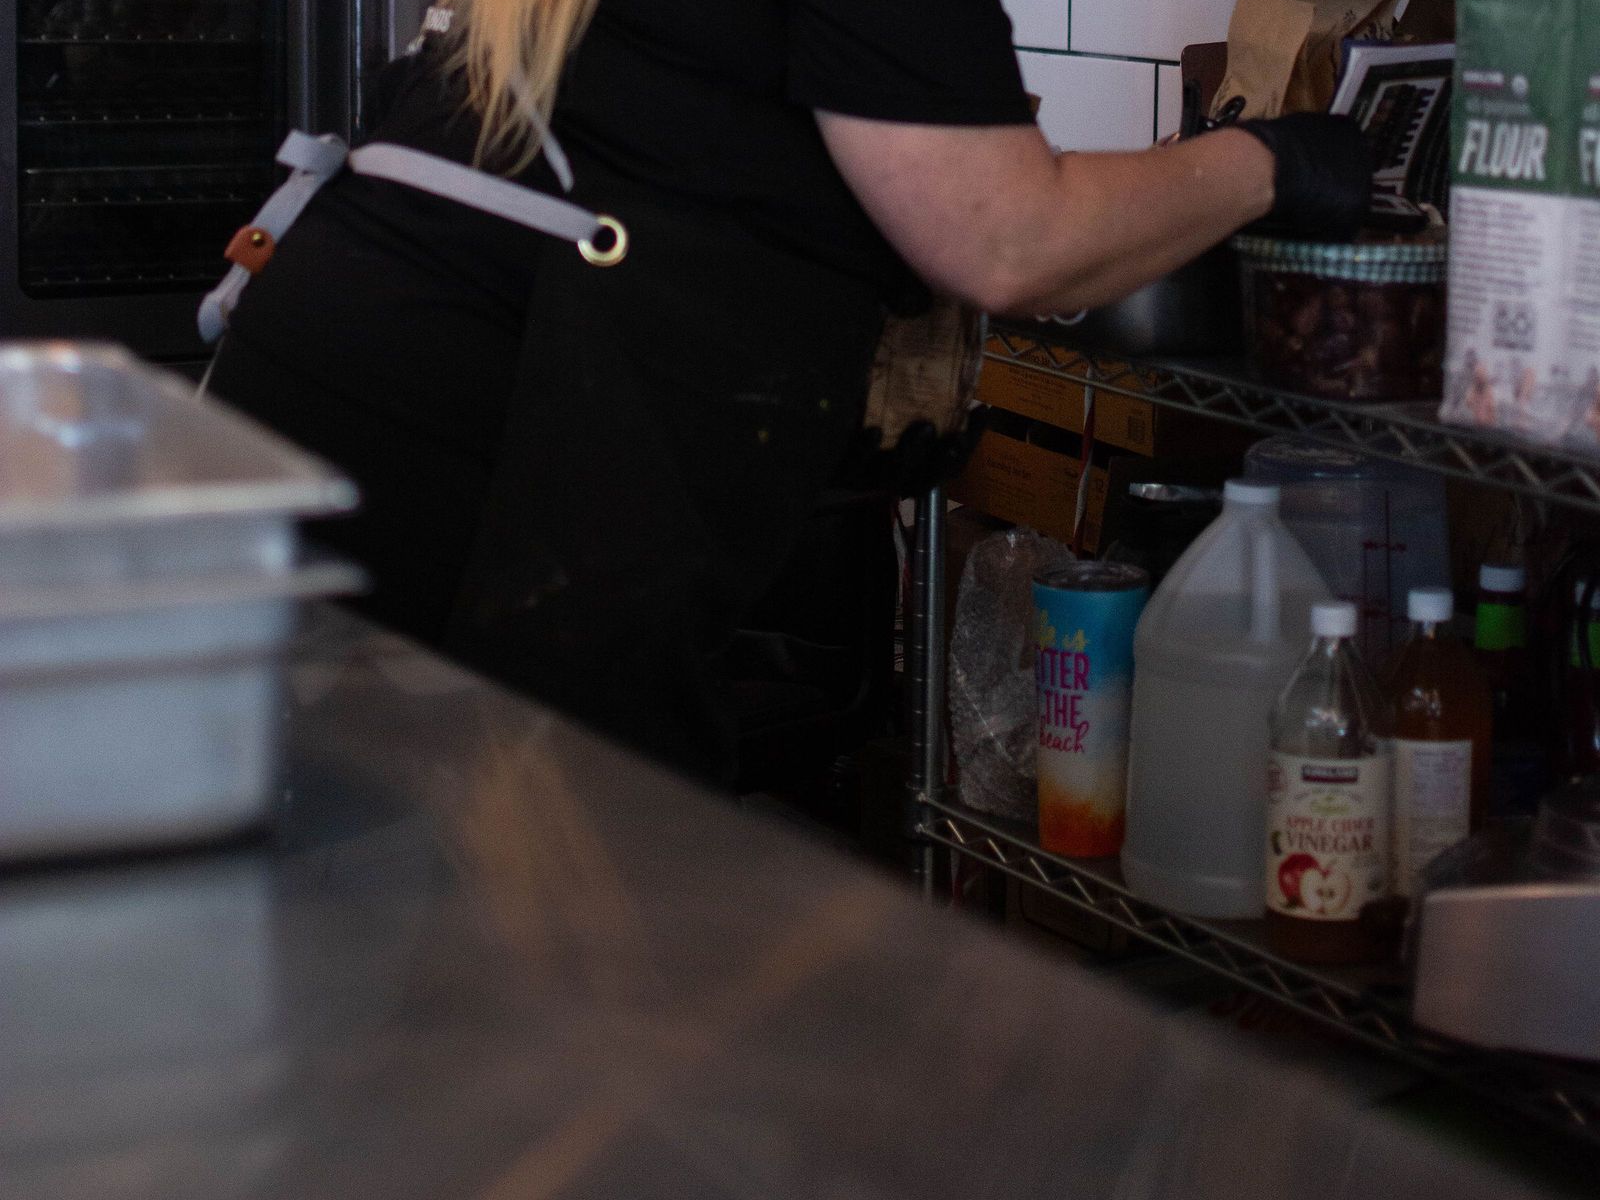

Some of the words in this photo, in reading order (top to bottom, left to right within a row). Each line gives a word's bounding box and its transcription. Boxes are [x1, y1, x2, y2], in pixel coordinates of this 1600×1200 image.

[1458, 117, 1549, 182] FLOUR
[1287, 815, 1326, 832] APPLE
[1286, 831, 1374, 853] VINEGAR
